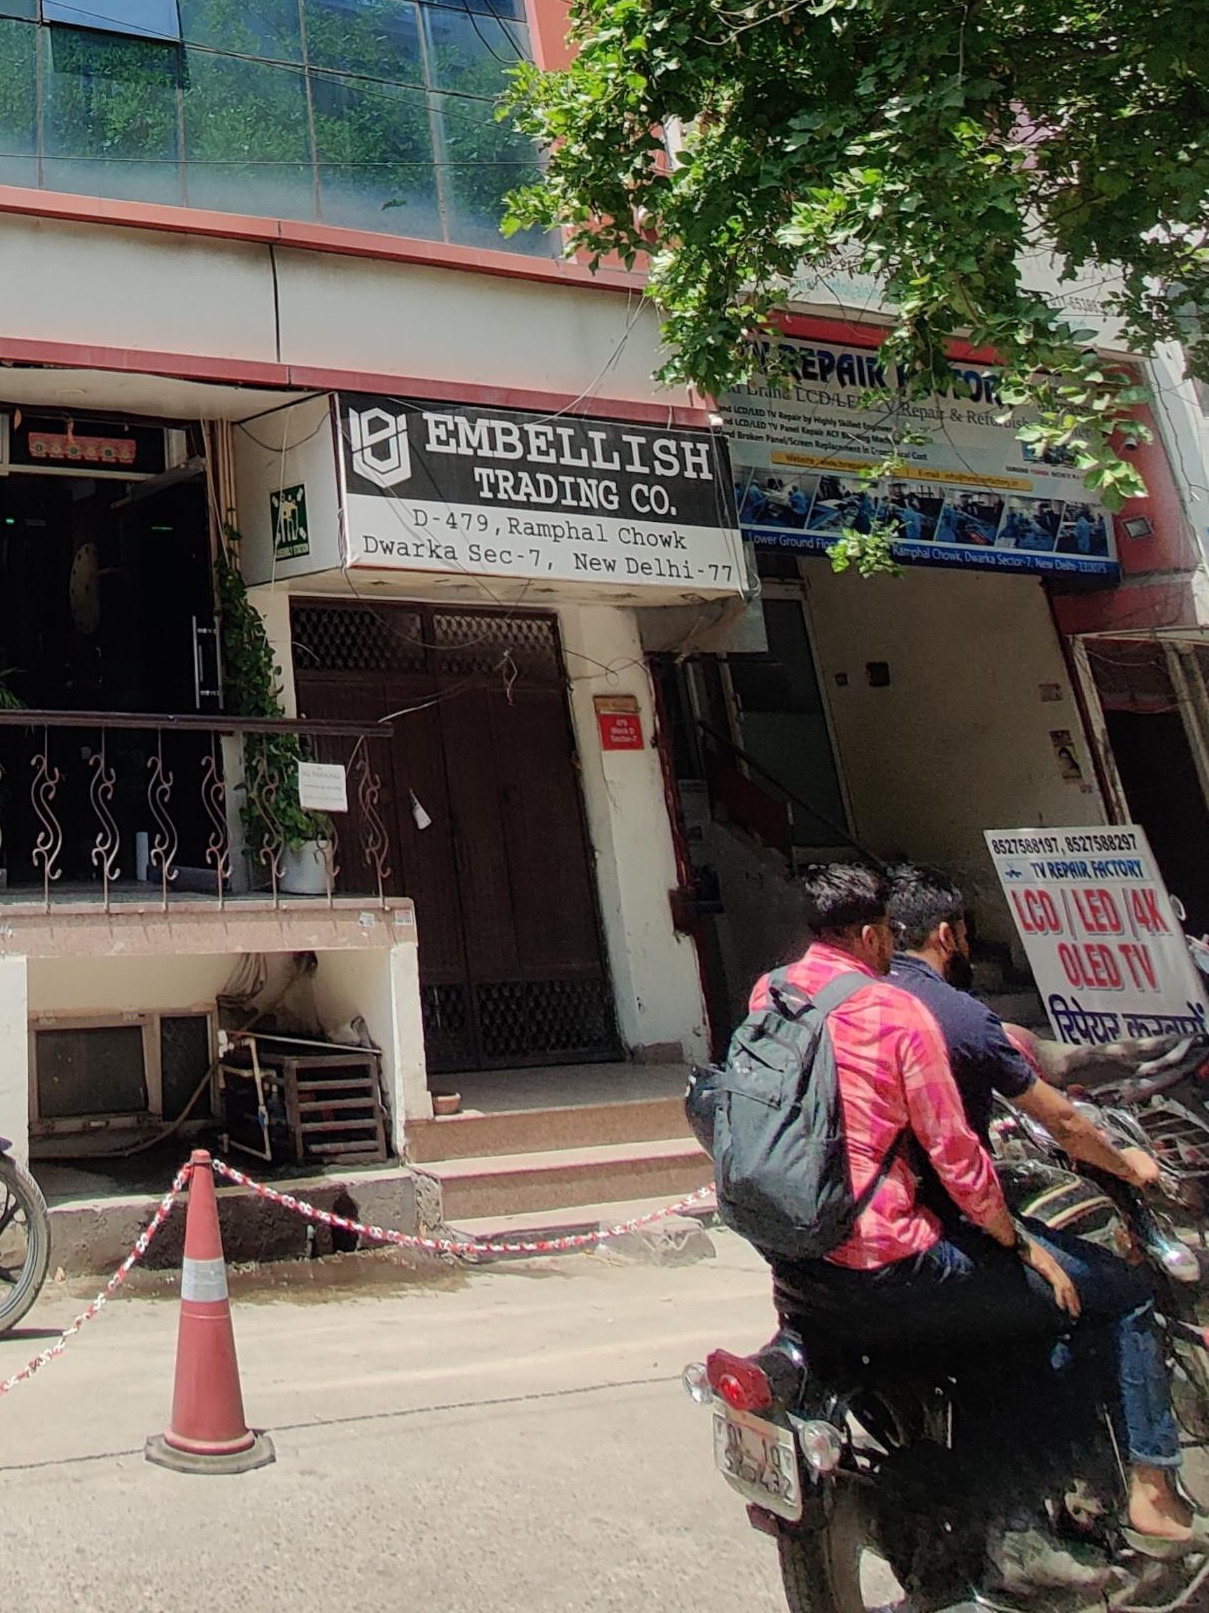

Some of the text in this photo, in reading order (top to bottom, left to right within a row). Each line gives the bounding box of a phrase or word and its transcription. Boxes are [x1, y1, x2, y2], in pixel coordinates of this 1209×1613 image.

[734, 406, 766, 417] LCD/LED
[767, 410, 777, 418] TV
[779, 411, 802, 423] Repair
[902, 402, 944, 423] Repair
[949, 409, 963, 422] &
[735, 418, 767, 429] LCD/LED
[769, 422, 778, 431] TV
[780, 424, 800, 434] Panel
[738, 432, 765, 442] Broken
[423, 412, 714, 481] EMBELLISH
[474, 467, 677, 516] TRADING CO.
[618, 527, 687, 551] Chowk
[780, 534, 822, 550] Ground
[964, 551, 996, 566] Dwarka
[363, 535, 733, 584] Dwarka Sec-7, New Delhi-77
[992, 833, 1139, 855] 8527588197, 8527588297
[1030, 859, 1145, 880] TV REPAIR FACTORY
[1011, 890, 1062, 934] LCD
[1071, 888, 1125, 935] LED
[1057, 942, 1159, 991] OLED TV
